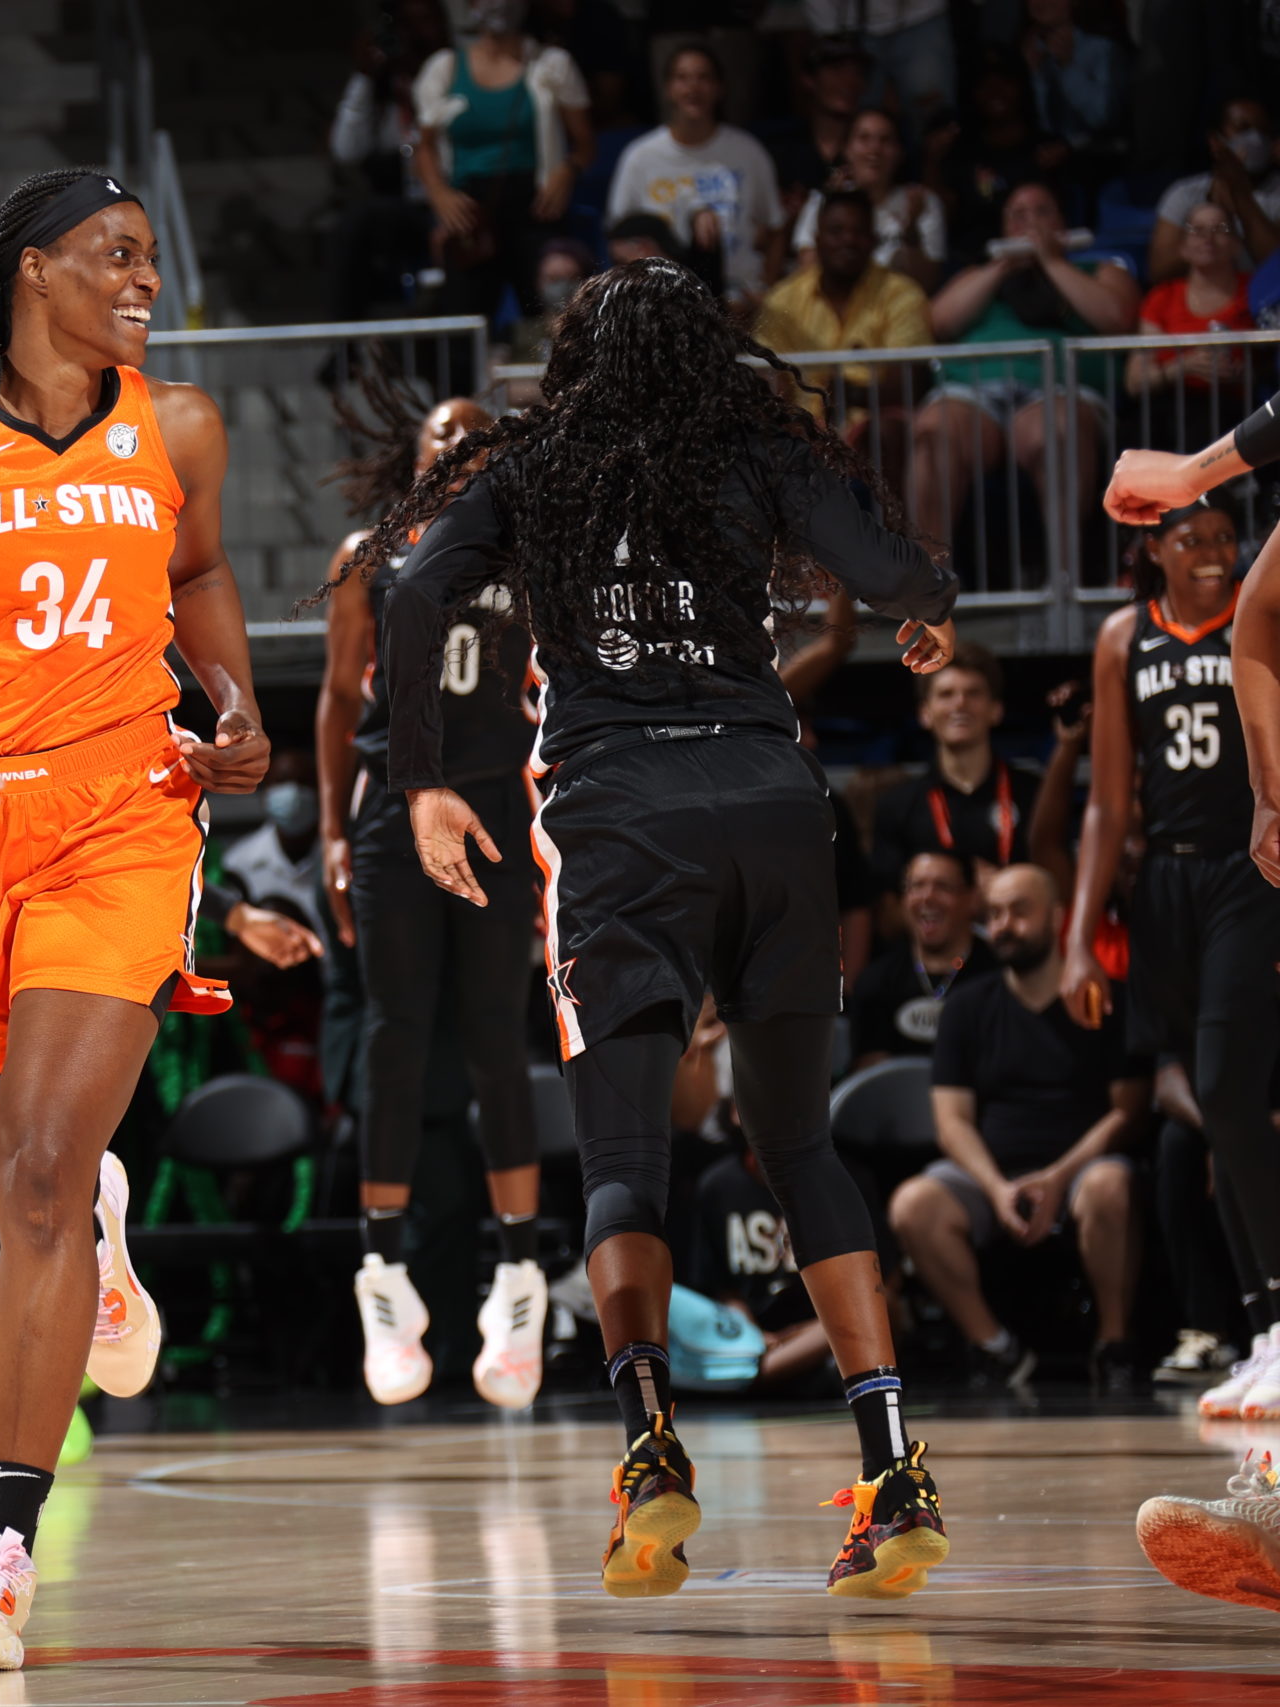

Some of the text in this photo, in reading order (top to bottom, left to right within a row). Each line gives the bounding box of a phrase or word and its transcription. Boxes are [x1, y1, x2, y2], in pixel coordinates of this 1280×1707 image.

[56, 483, 159, 531] STAR
[16, 558, 113, 650] 34
[439, 624, 480, 696] 0
[643, 639, 715, 666] T&T
[1136, 654, 1233, 702] ALL STA
[1165, 702, 1221, 771] 35
